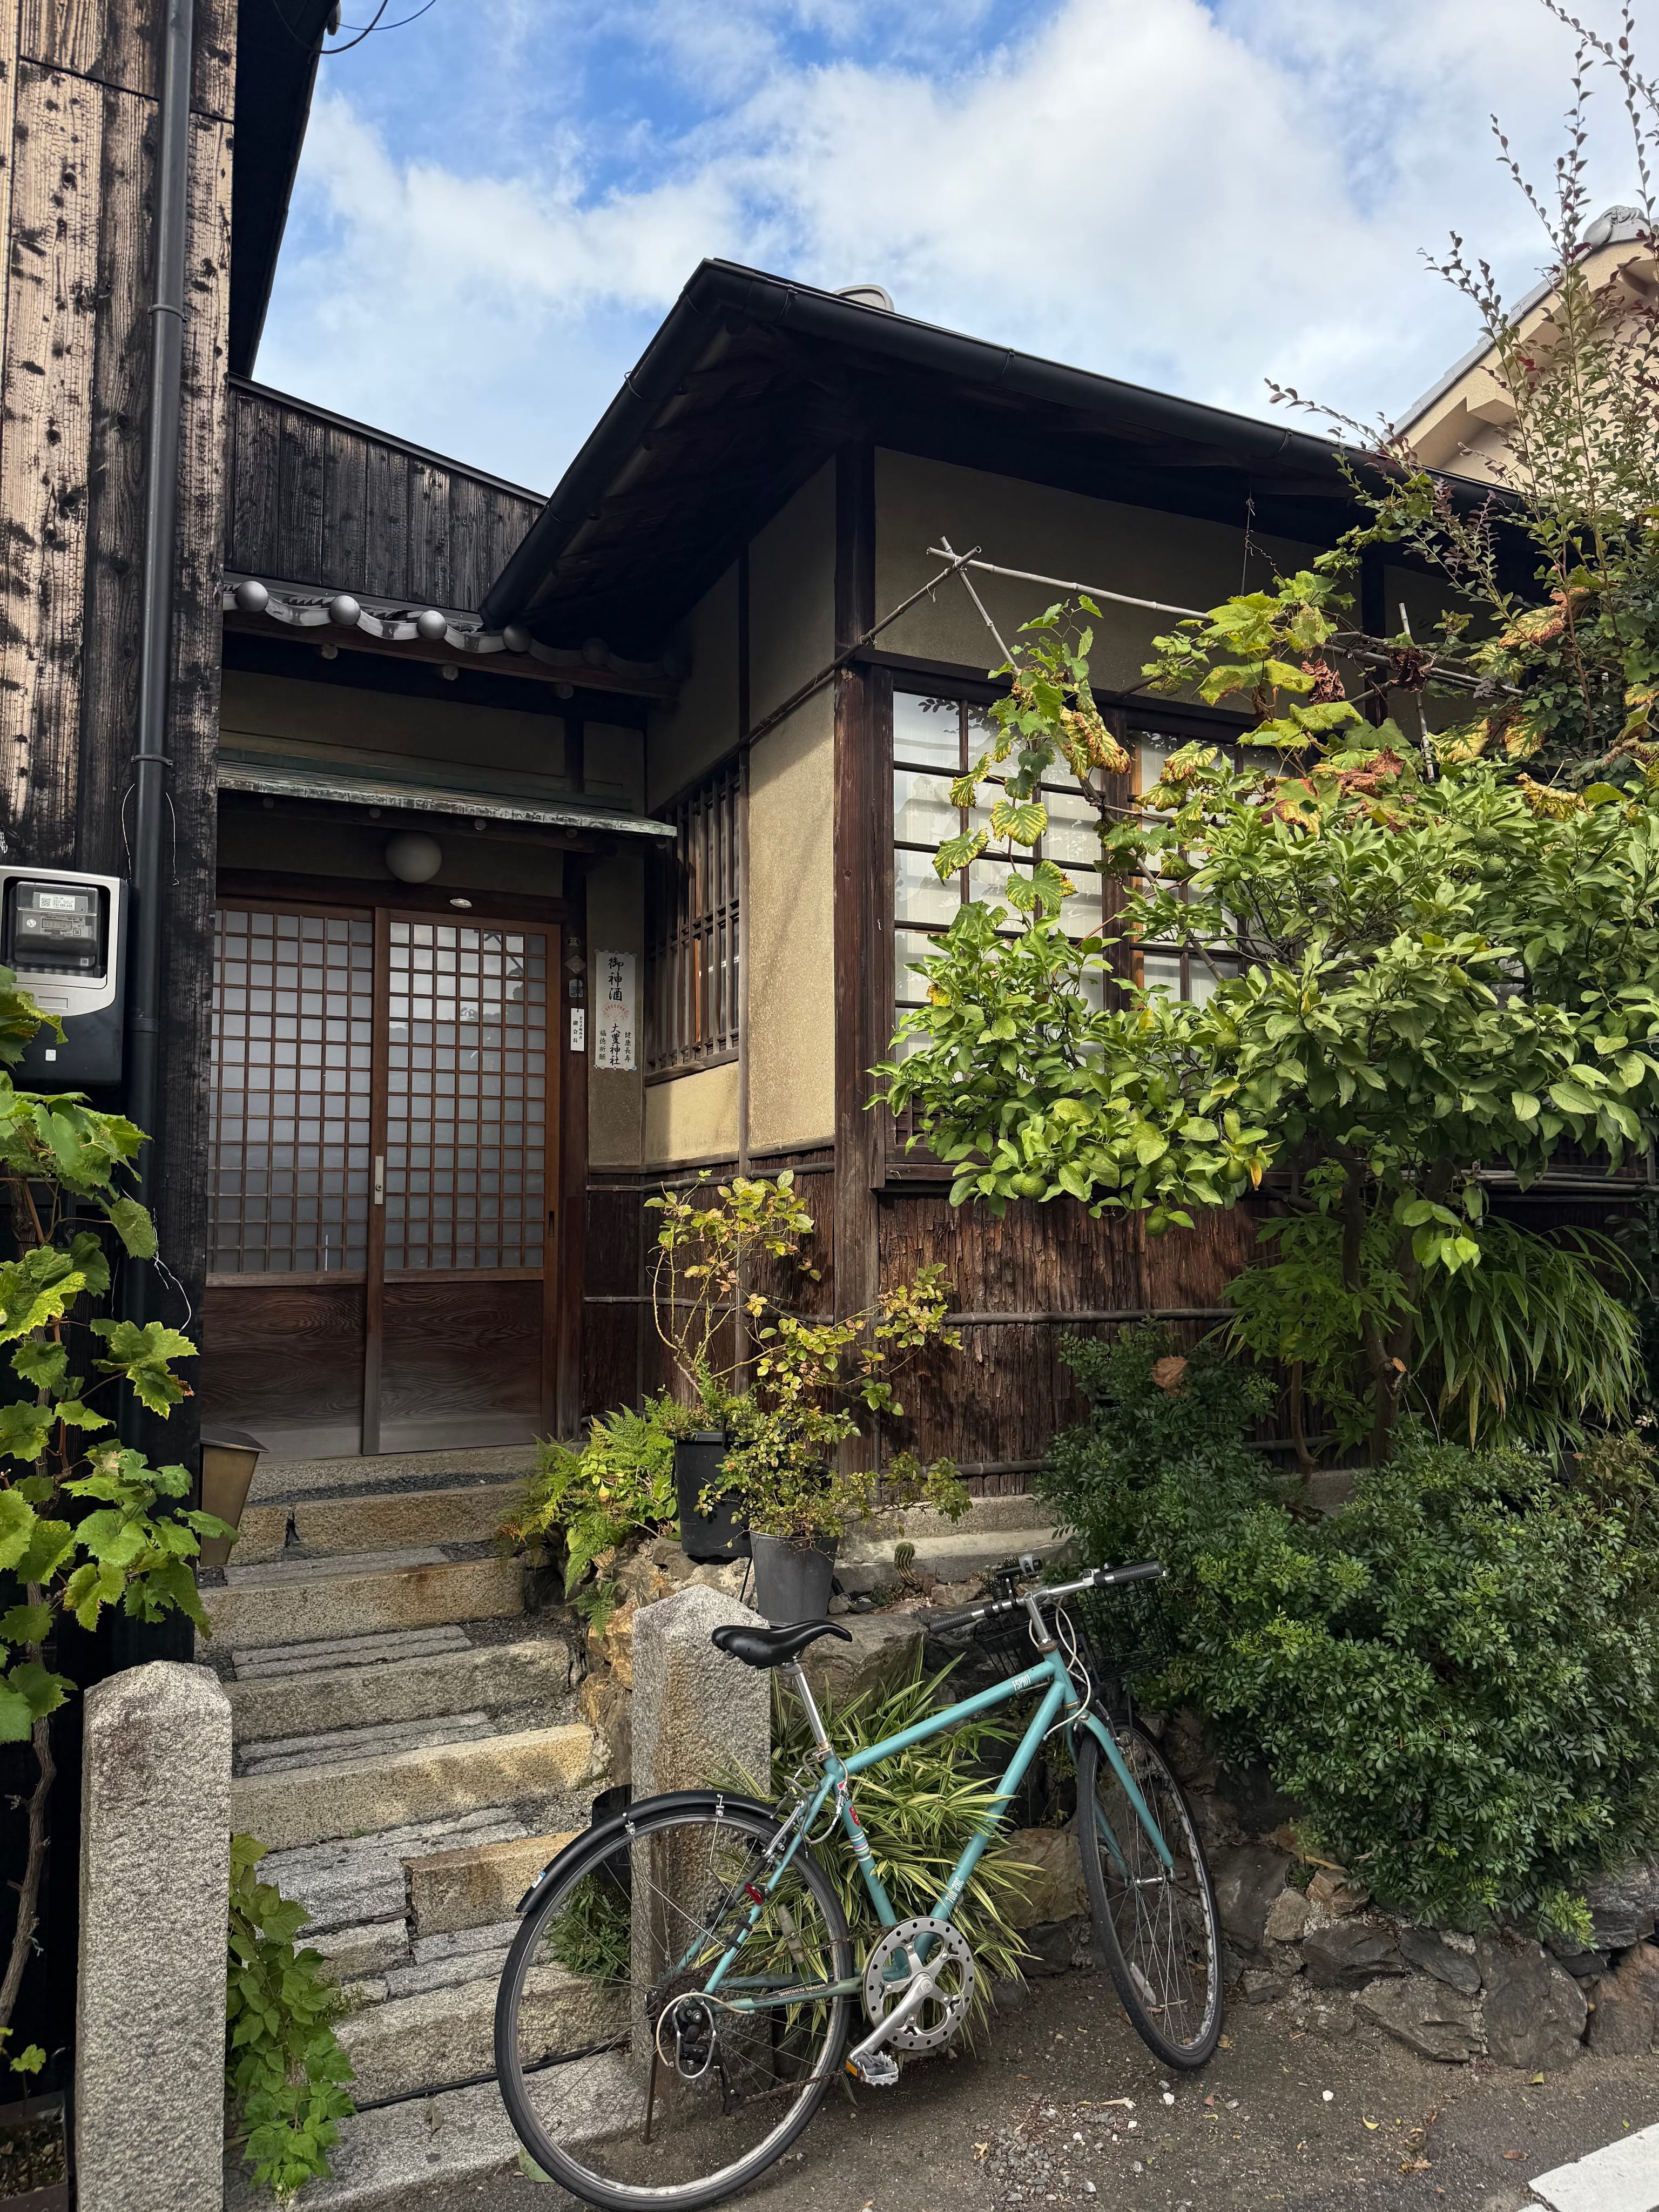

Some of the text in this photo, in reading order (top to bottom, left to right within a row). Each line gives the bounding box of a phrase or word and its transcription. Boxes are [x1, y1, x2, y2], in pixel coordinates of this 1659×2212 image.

[608, 956, 624, 1002] 御神酒
[609, 1023, 621, 1066] 大豊神社
[1011, 1674, 1031, 1691] ESPRIT
[778, 1987, 805, 1997] SHIMANO
